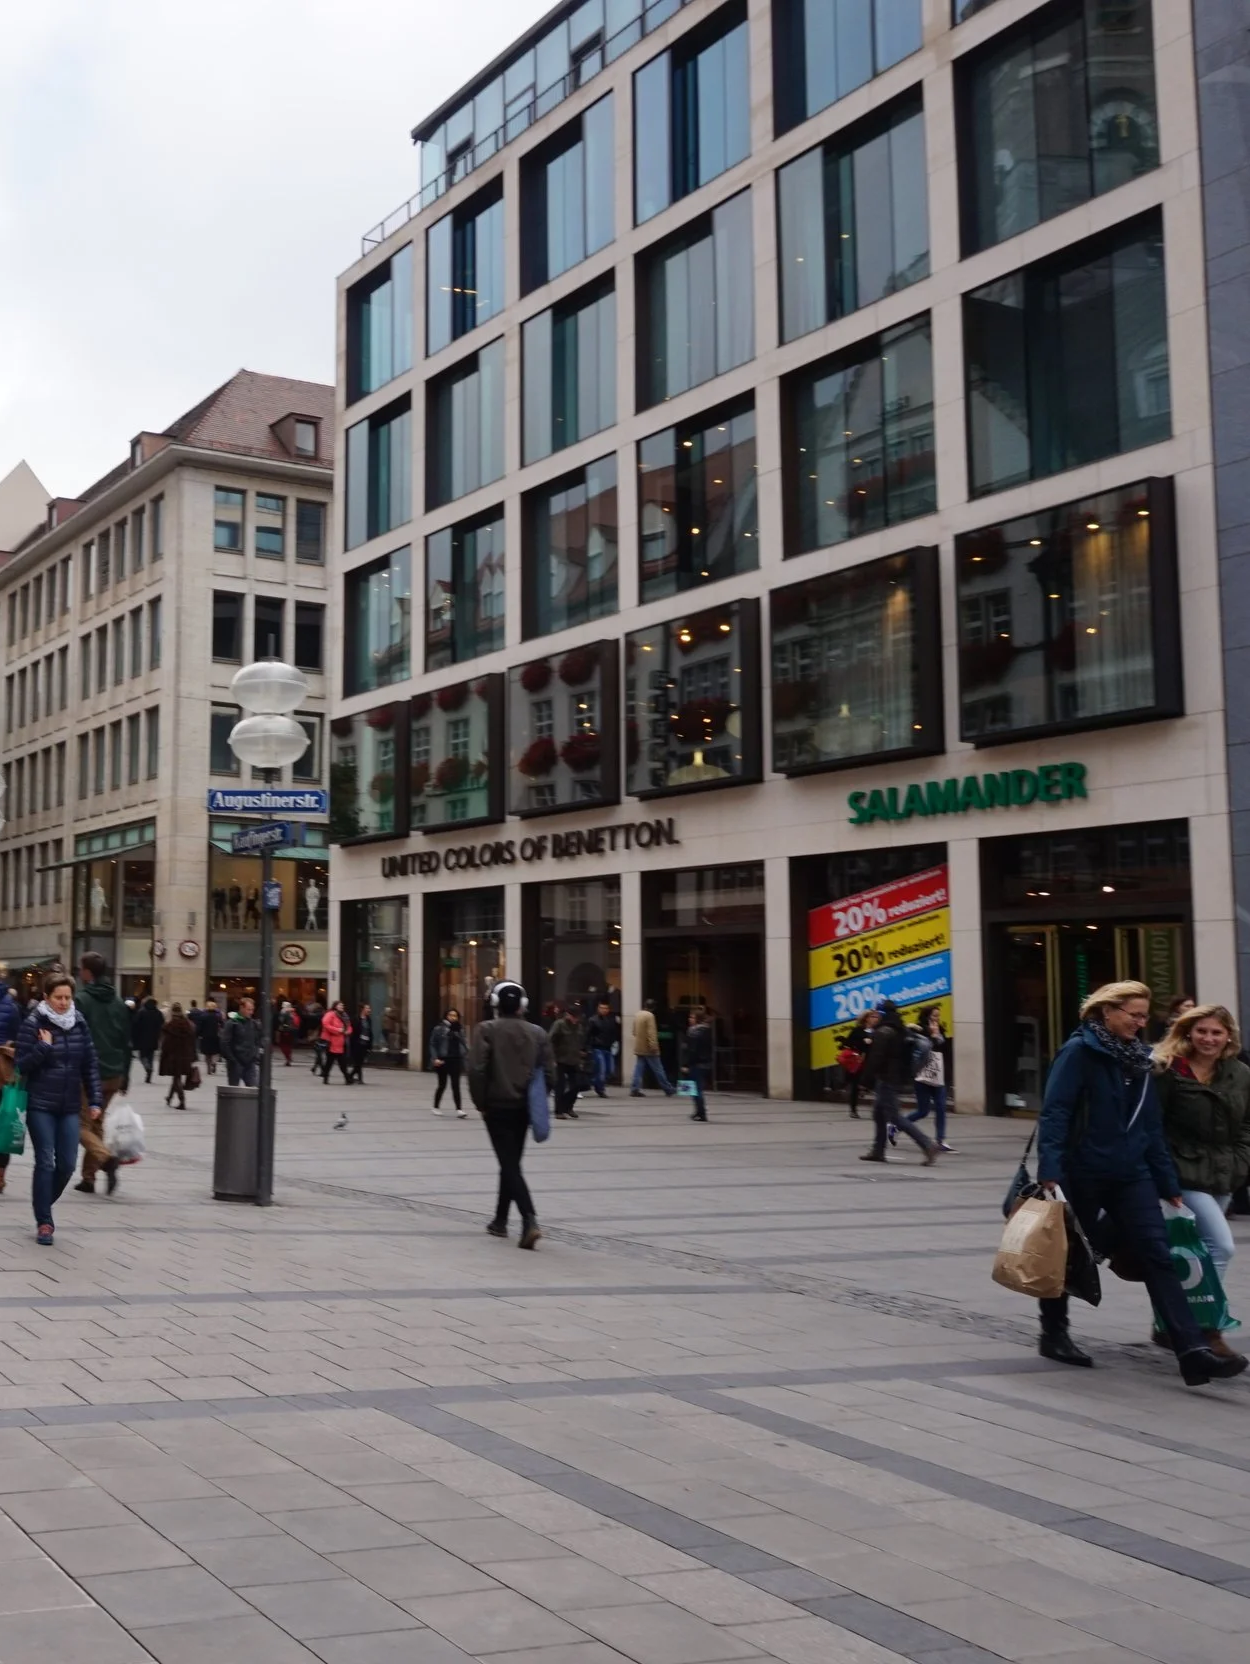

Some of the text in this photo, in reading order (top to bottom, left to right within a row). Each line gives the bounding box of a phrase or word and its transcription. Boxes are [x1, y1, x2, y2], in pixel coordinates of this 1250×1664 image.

[213, 791, 320, 811] Augustinerstr.
[848, 762, 1088, 825] SALAMANDER
[381, 851, 440, 878] UNITED
[444, 842, 516, 871] COLORS
[520, 834, 548, 861] OF
[832, 898, 888, 937] 20%
[832, 941, 885, 978] 20%
